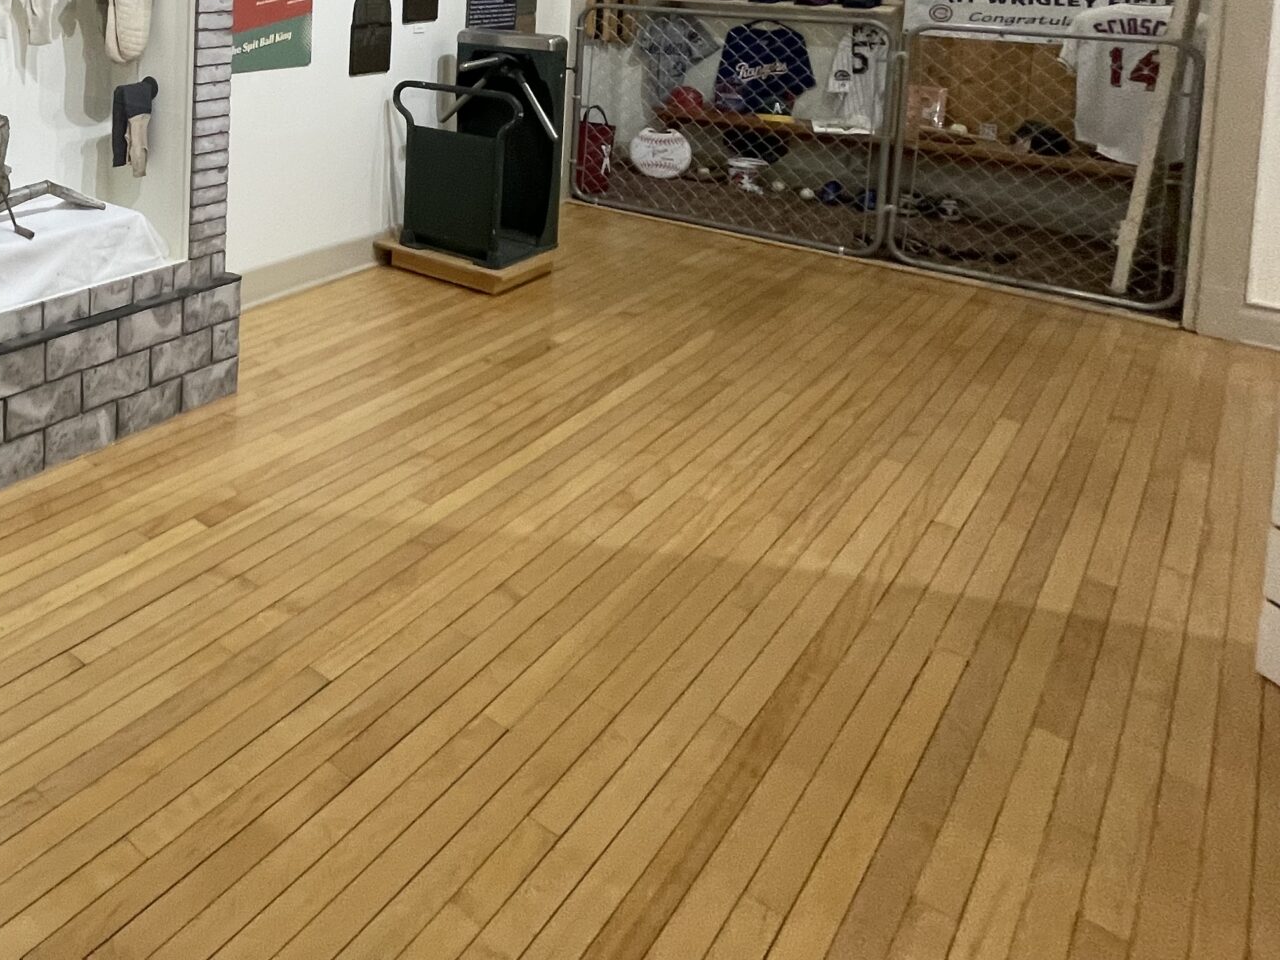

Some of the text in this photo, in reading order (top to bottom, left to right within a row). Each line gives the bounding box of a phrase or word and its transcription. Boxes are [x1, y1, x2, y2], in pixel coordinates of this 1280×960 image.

[242, 40, 259, 53] Spit
[260, 33, 275, 48] Ball
[275, 31, 292, 43] King
[1109, 47, 1160, 92] 14
